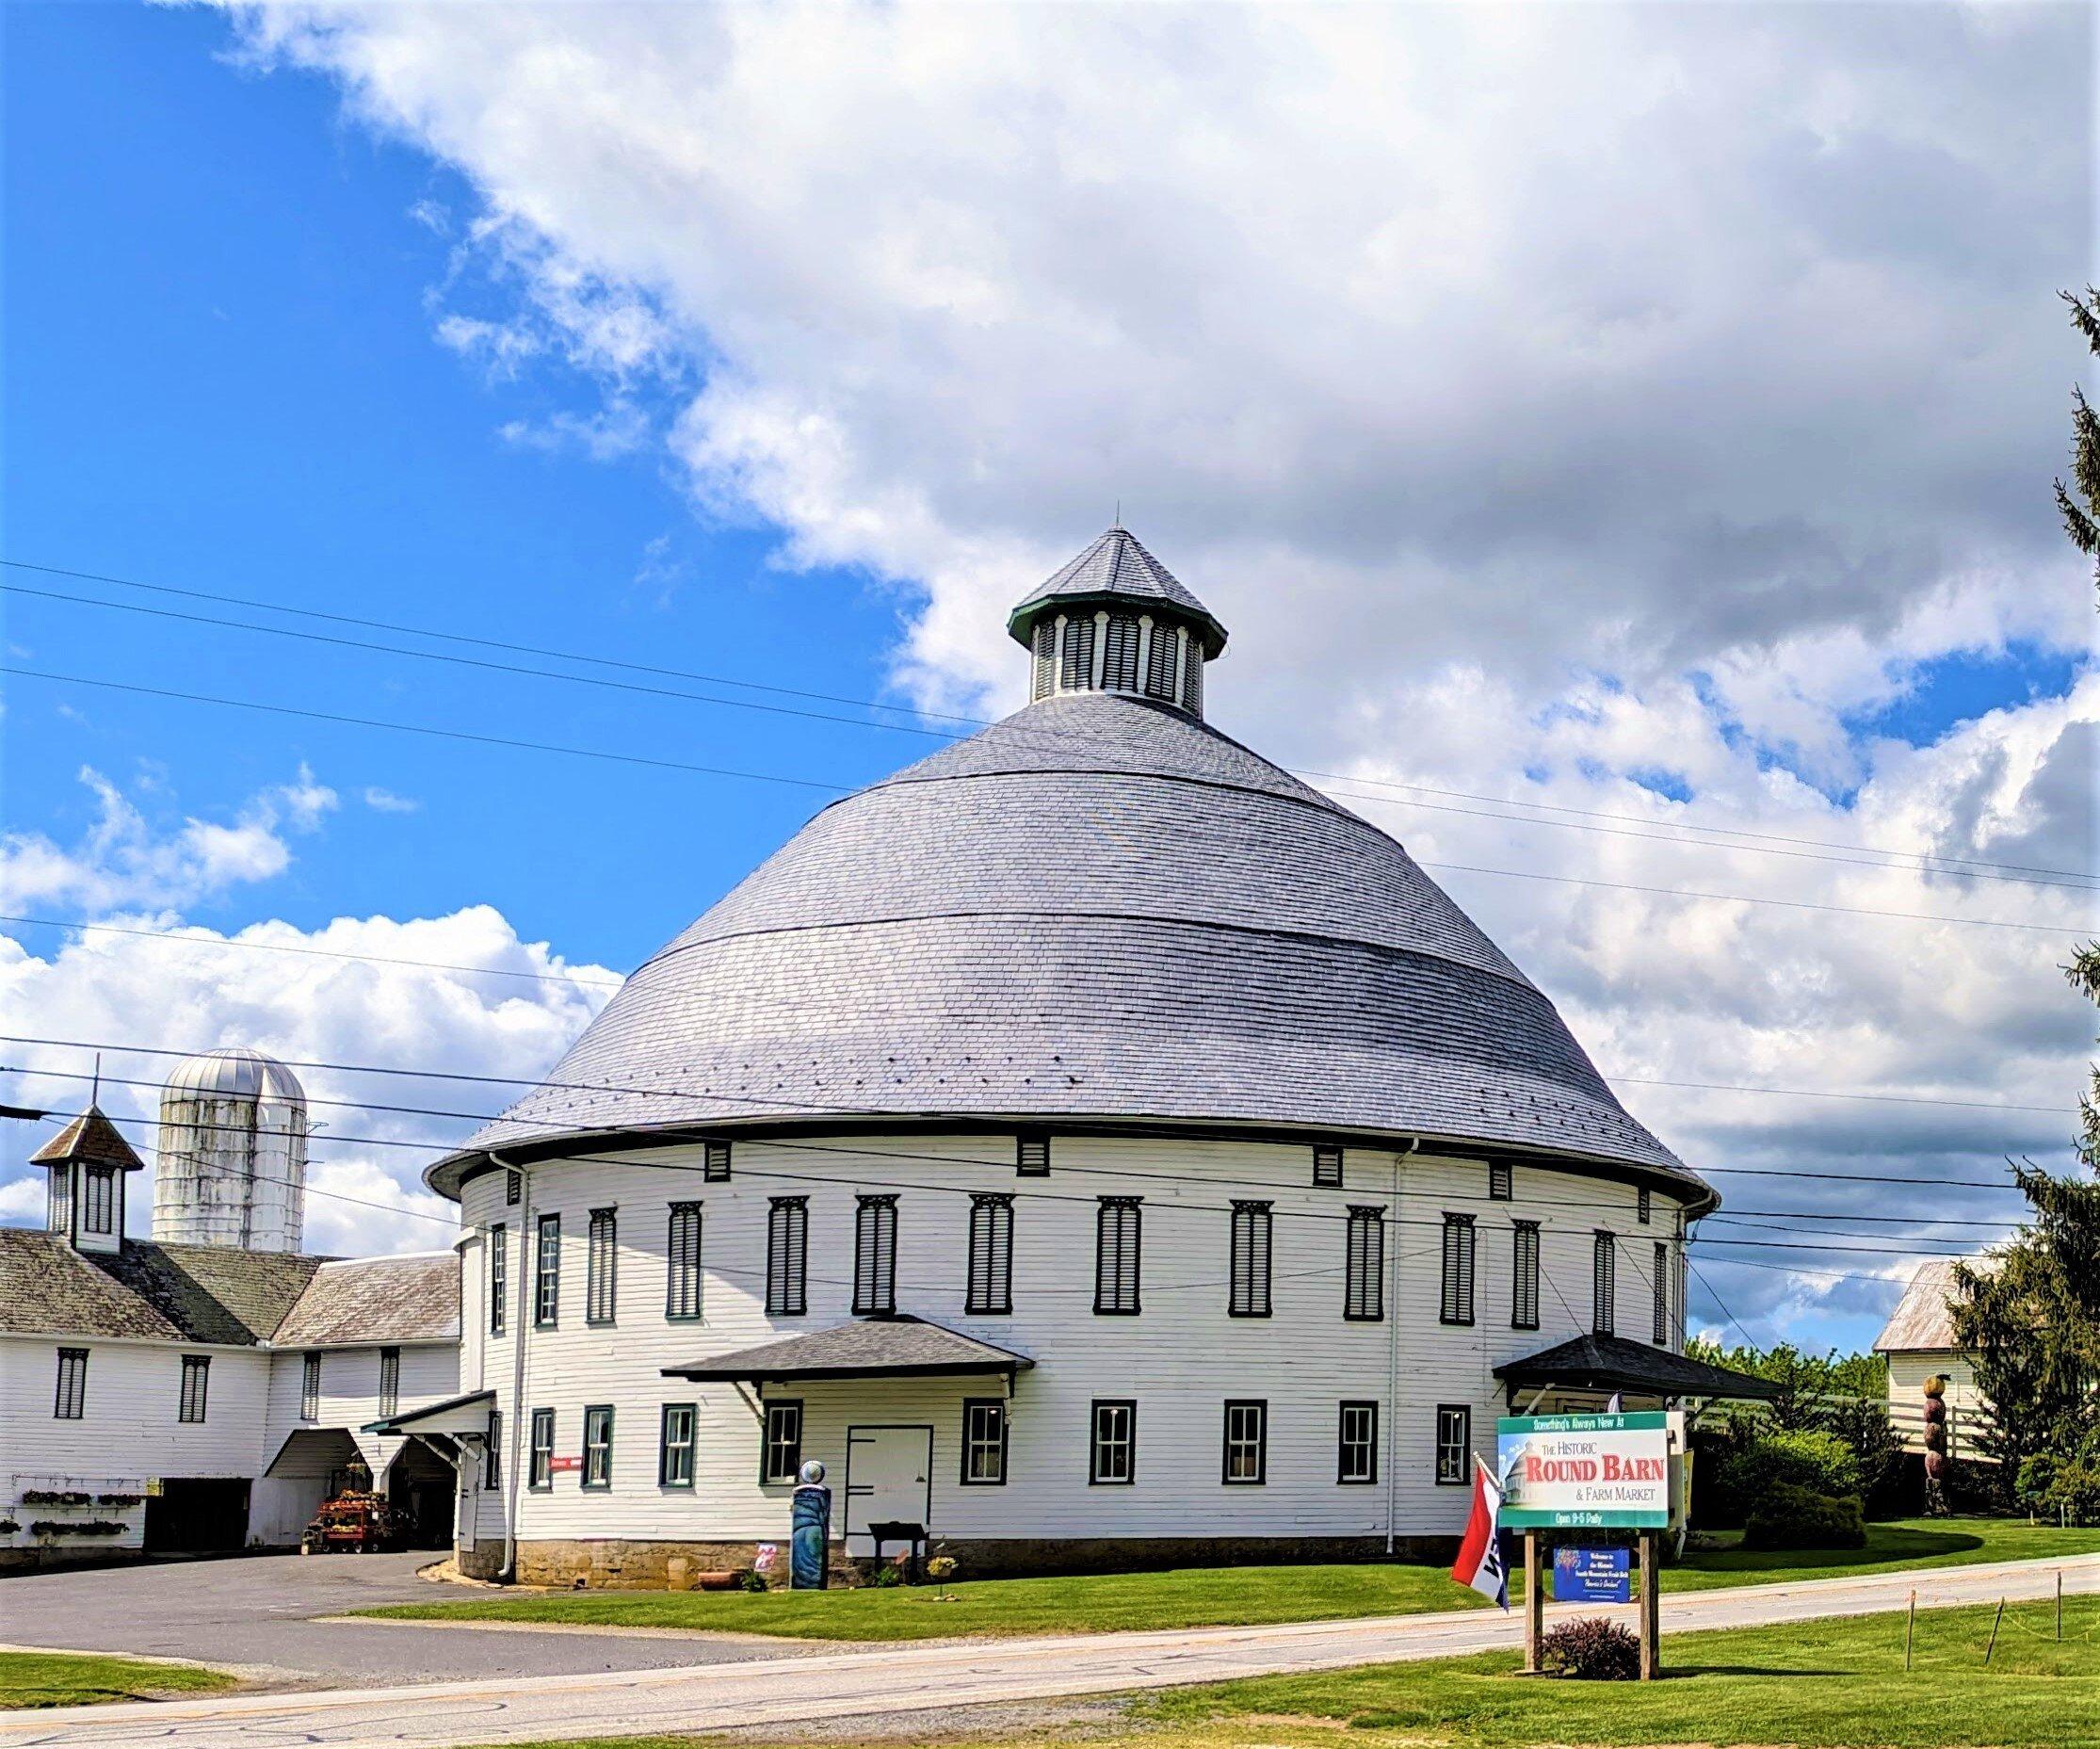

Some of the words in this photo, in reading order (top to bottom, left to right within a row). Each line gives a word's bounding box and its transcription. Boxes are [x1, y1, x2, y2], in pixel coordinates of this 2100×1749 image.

[1598, 1417, 1614, 1428] New
[1542, 1445, 1556, 1455] THE
[1558, 1441, 1597, 1454] HISTORIC
[1526, 1456, 1597, 1482] ROUND
[1602, 1453, 1665, 1482] BARN
[1576, 1491, 1583, 1501] &
[1586, 1487, 1613, 1501] FARM
[1615, 1486, 1656, 1501] MARKET
[1555, 1512, 1571, 1526] Open
[1586, 1512, 1603, 1526] Daily
